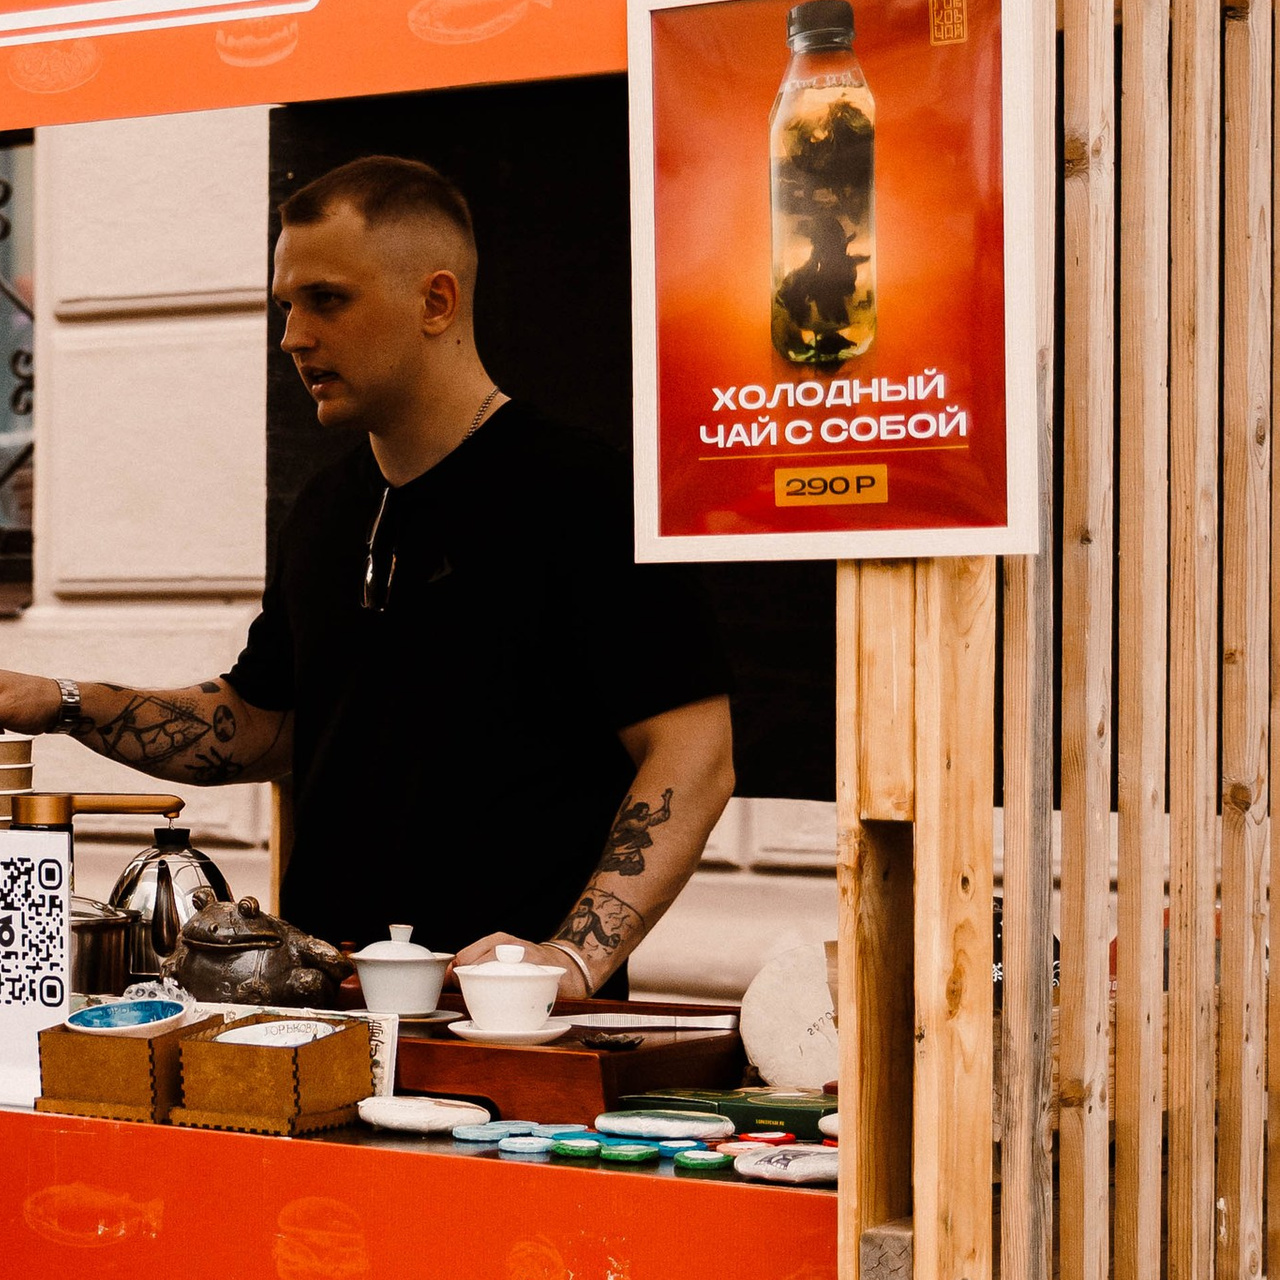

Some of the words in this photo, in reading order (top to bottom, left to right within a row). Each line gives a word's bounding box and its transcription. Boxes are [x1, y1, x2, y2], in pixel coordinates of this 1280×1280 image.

[711, 367, 946, 412] ХОЛОДНЫЙ
[698, 414, 778, 449] ЧАЙ
[784, 419, 813, 445] С
[820, 405, 968, 444] СОБОЙ
[785, 476, 850, 497] 290
